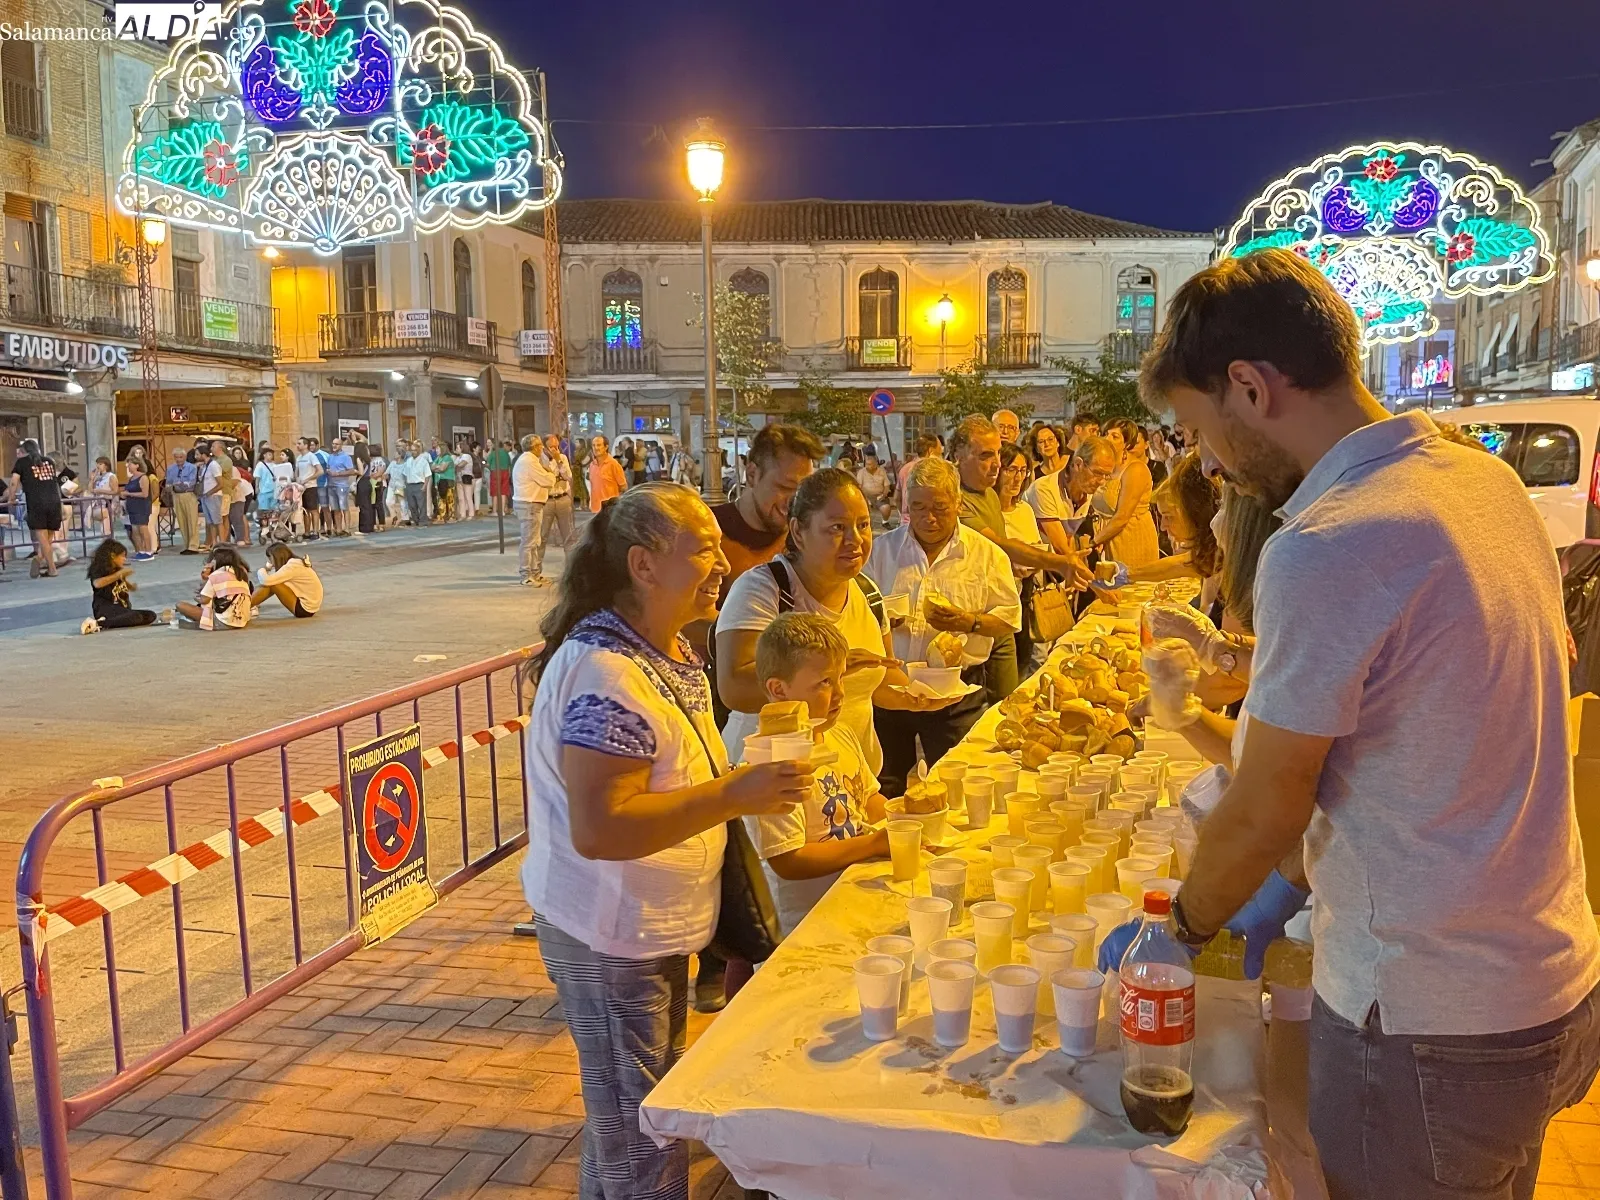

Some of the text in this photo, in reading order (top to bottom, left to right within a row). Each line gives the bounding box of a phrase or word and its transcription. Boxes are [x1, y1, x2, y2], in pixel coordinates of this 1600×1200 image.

[205, 303, 236, 315] VENDE
[9, 333, 129, 369] EMBUTIDOS
[0, 376, 38, 389] CUTERÍA
[350, 733, 420, 774] PROHIBIDO ESTACIONAR
[367, 882, 401, 912] POLICÍA
[401, 868, 426, 888] LOCAL
